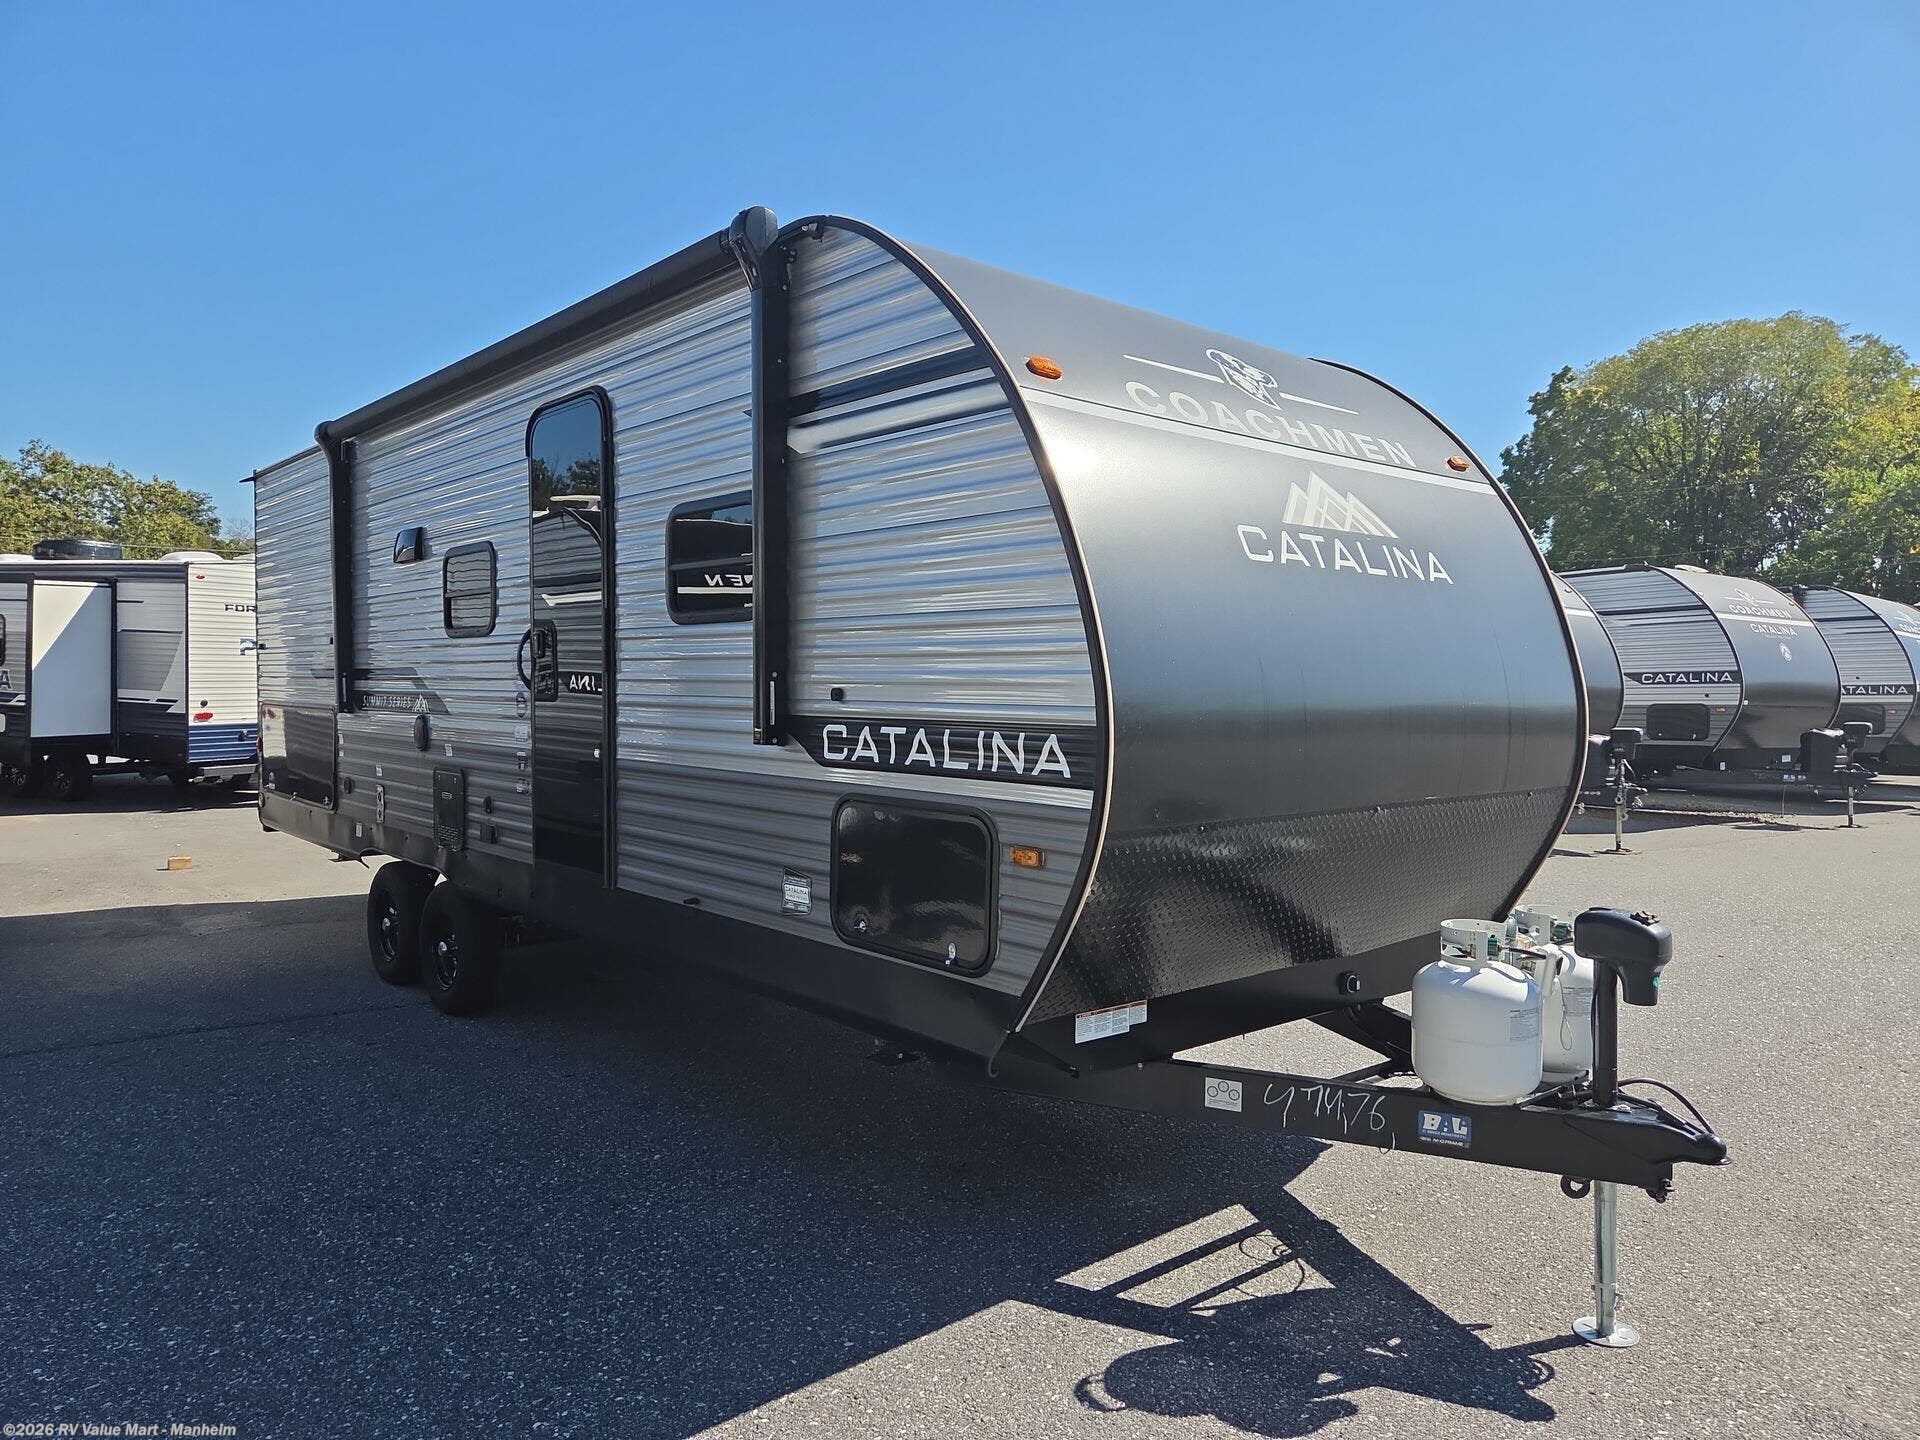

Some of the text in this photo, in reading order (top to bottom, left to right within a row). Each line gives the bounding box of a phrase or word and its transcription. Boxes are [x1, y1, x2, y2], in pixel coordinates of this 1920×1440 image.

[1125, 381, 1416, 468] COACHMEN
[1237, 524, 1454, 585] CATALINA
[1728, 604, 1792, 618] COACHMEN
[1750, 623, 1798, 636] CATALINA
[1641, 672, 1733, 684] CATALINA
[363, 695, 411, 708] SUMMIT SERIES
[822, 724, 1072, 779] CATALINA
